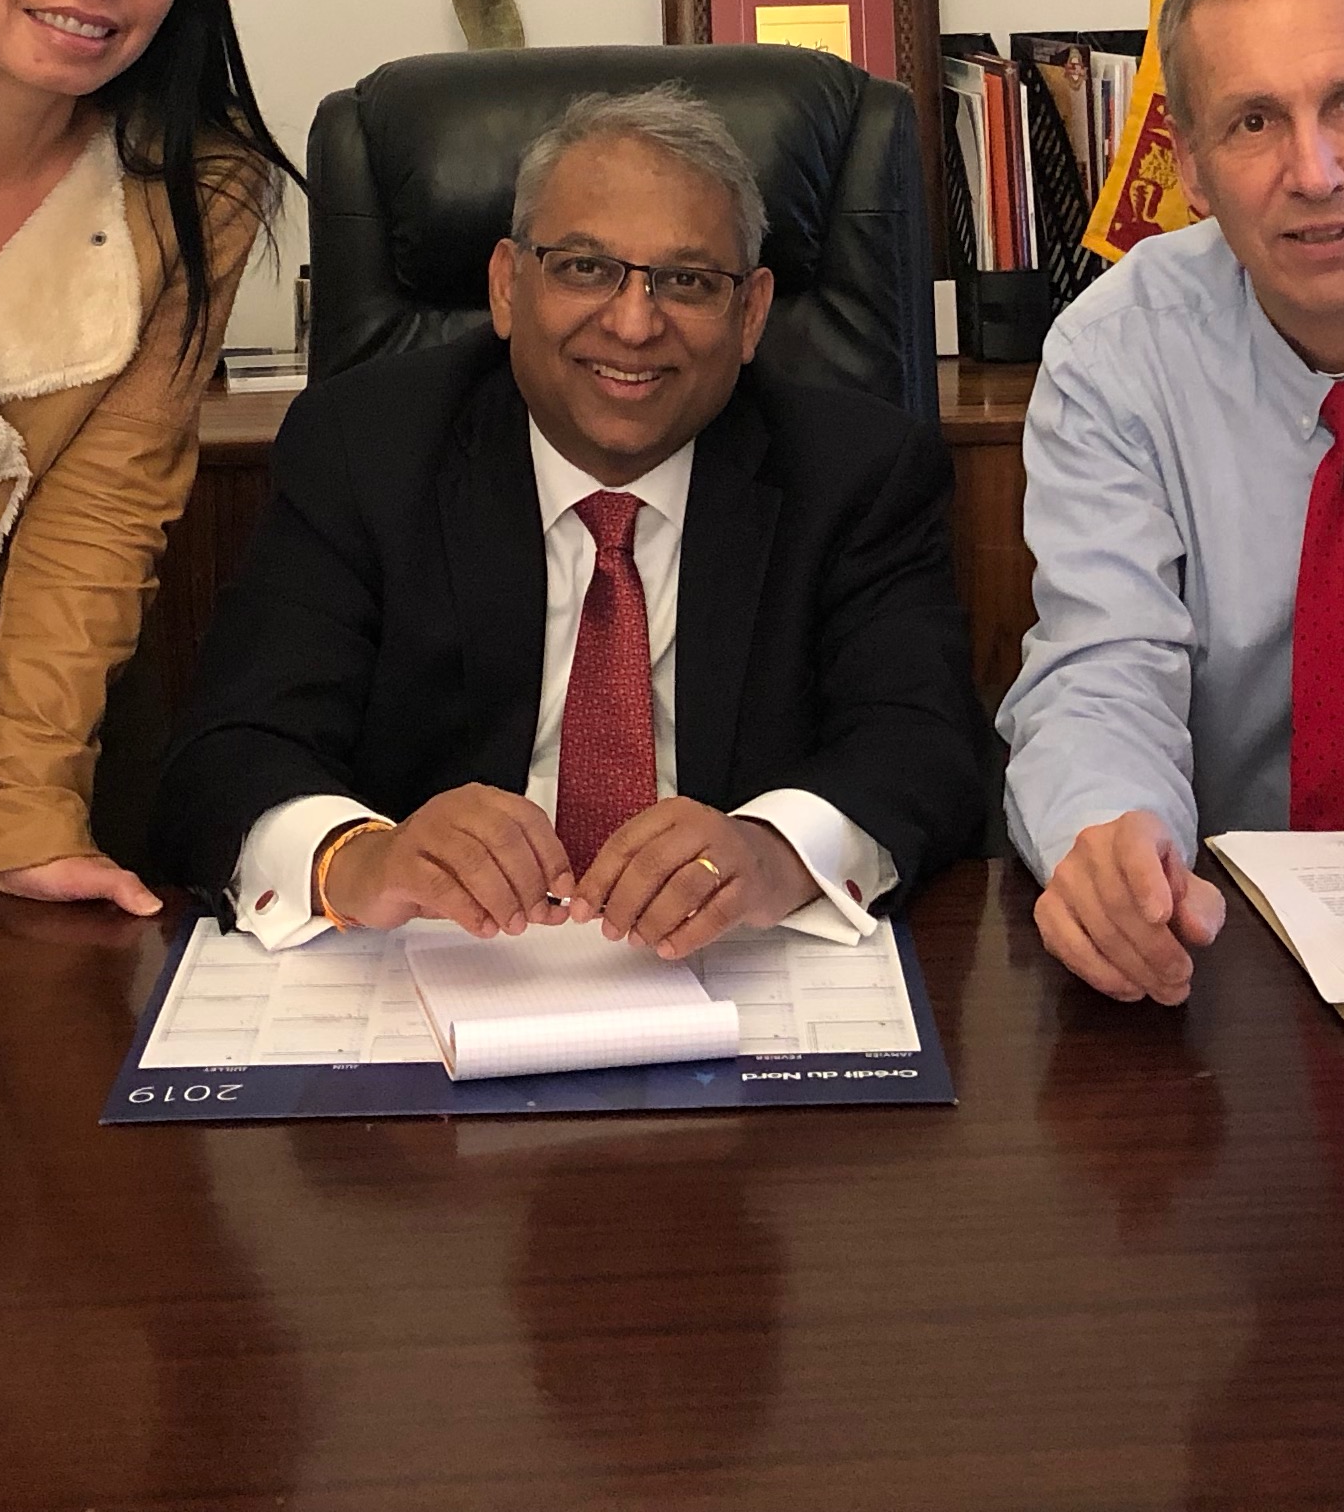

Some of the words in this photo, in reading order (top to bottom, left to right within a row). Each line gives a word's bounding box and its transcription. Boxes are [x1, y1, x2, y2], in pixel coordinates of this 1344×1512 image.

[741, 1071, 802, 1083] Nord
[807, 1070, 839, 1081] du
[843, 1069, 919, 1080] Crédit
[128, 1084, 244, 1103] 2019
